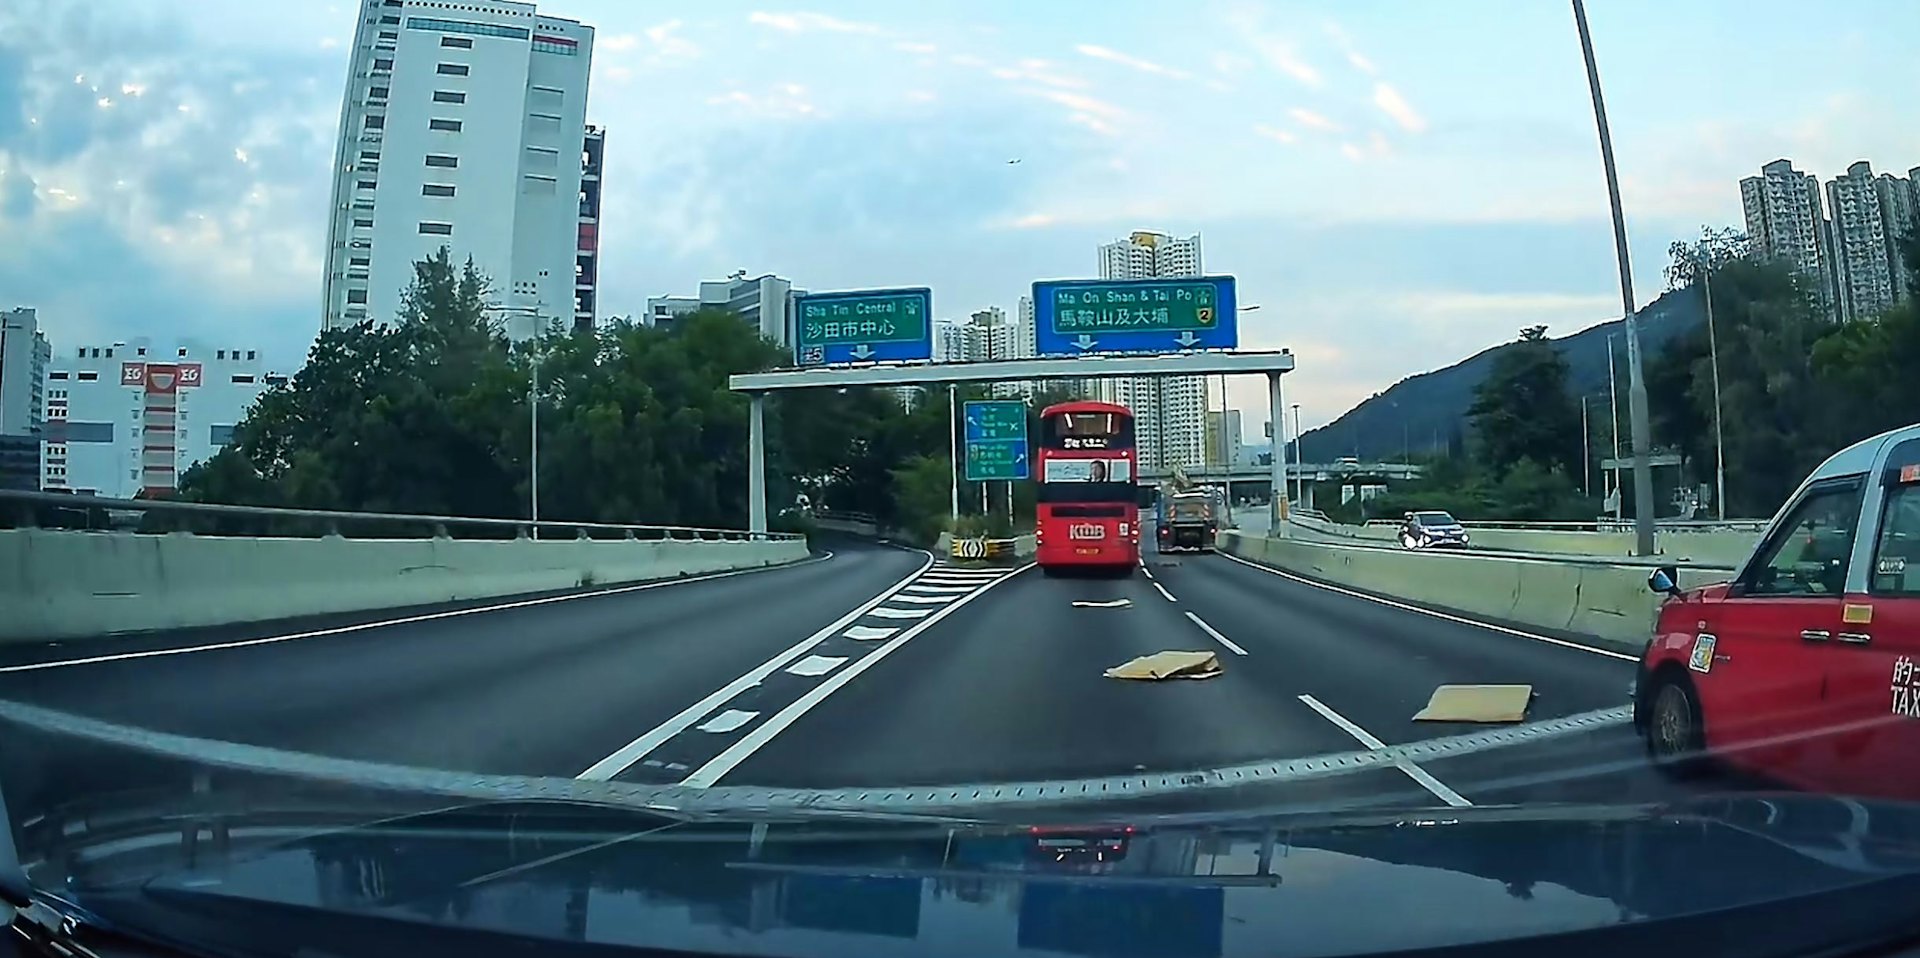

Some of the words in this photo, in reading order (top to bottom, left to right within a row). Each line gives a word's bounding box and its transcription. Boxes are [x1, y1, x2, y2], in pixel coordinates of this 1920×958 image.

[1058, 293, 1075, 305] Ma
[1082, 291, 1100, 304] On
[1106, 290, 1136, 303] Shan
[1140, 289, 1149, 302] &
[1152, 289, 1170, 302] Tai
[1176, 288, 1193, 301] Po
[806, 306, 826, 317] Sha
[832, 305, 849, 316] Tin
[856, 301, 896, 315] Central
[1058, 307, 1169, 327] 馬鞍山及大埔
[1200, 309, 1209, 321] 2
[805, 319, 896, 339] 沙田市中心
[1069, 522, 1106, 540] KMB
